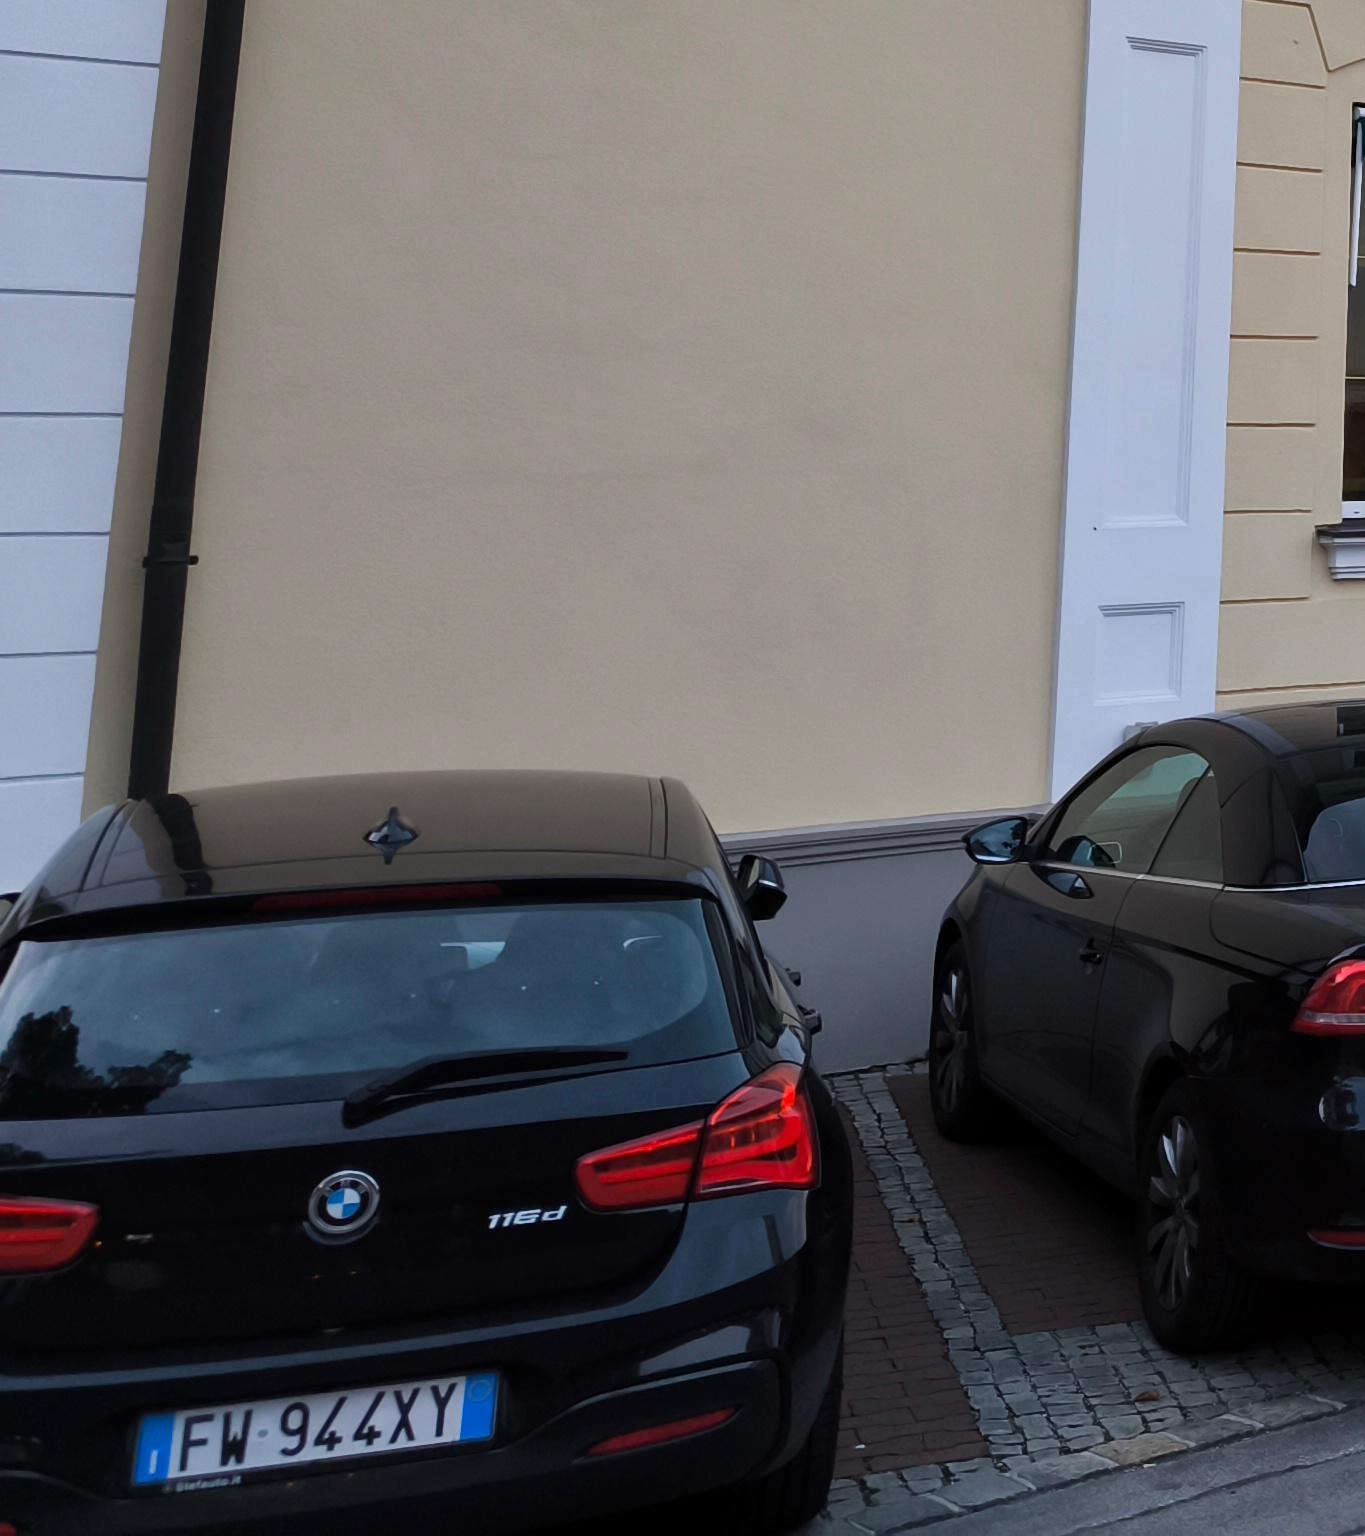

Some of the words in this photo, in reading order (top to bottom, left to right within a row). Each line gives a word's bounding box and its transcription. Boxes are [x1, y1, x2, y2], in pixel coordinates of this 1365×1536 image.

[488, 1206, 567, 1229] 116d
[179, 1409, 253, 1472] FW
[280, 1382, 458, 1457] 944XY
